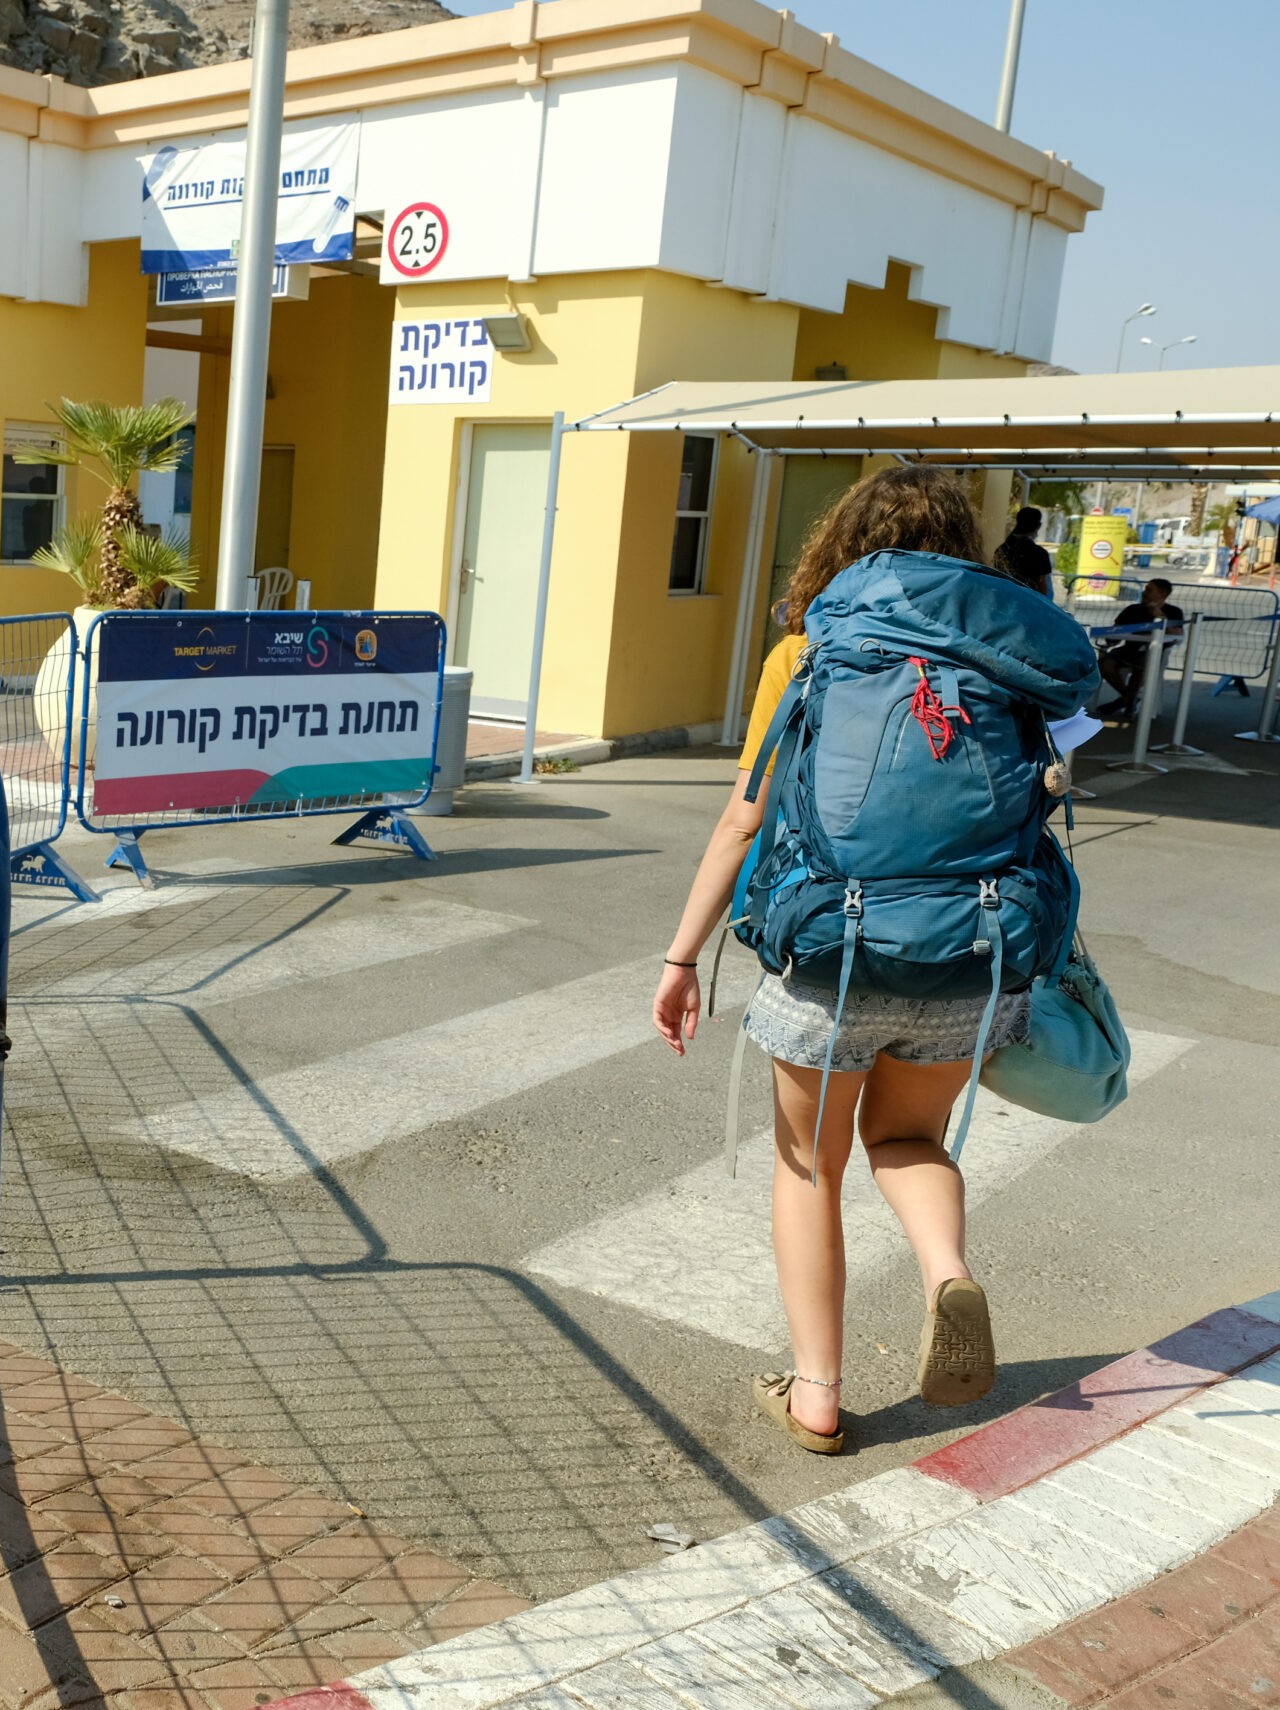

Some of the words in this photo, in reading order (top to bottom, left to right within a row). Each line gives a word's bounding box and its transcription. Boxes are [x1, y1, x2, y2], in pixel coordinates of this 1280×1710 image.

[167, 180, 215, 201] קורונה
[281, 167, 330, 188] מתחם
[399, 222, 437, 257] 2.5
[400, 319, 488, 358] בדיקת
[398, 360, 487, 395] קורונה
[174, 646, 205, 656] TARGET
[206, 645, 238, 655] MARKET
[274, 632, 304, 644] שיבא
[116, 707, 220, 753] קורונה
[232, 703, 328, 750] בדיקת
[338, 700, 419, 735] תחנת
